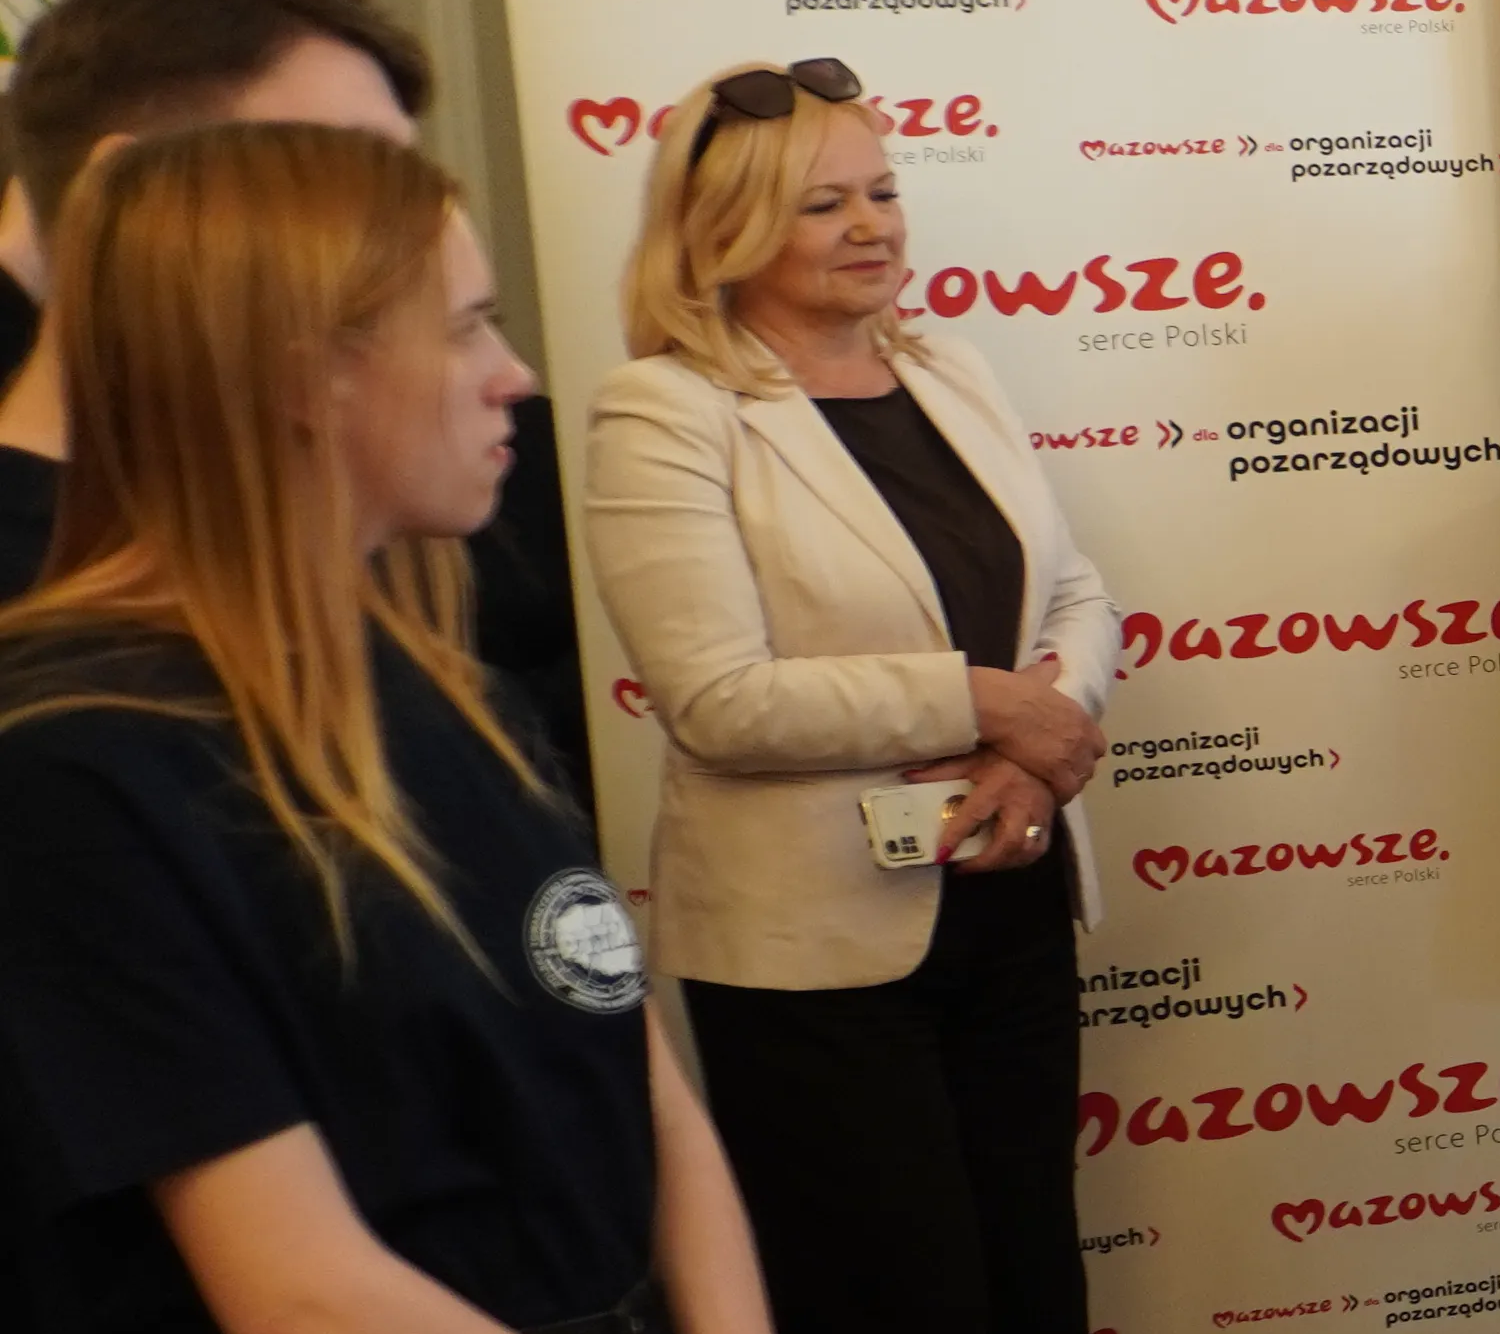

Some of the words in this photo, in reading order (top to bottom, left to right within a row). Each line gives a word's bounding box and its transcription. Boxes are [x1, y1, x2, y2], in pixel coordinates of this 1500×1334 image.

[1361, 22, 1403, 34] serce
[1409, 19, 1455, 34] Polski
[567, 94, 999, 157] Msze.
[924, 145, 985, 164] Polski
[1289, 128, 1433, 155] organizacji
[1291, 153, 1494, 182] pozarządowych
[896, 251, 1266, 319] owsze.
[1078, 329, 1154, 352] serce
[1165, 323, 1247, 348] Polski
[1028, 424, 1139, 450] owsze
[1192, 428, 1219, 441] dla
[1227, 406, 1419, 444] organizacji
[1399, 658, 1460, 680] serce
[1111, 727, 1260, 759] organizacji
[1113, 748, 1324, 787] pozarządowych
[1347, 873, 1388, 887] serce
[1395, 867, 1440, 884] Polski
[1079, 984, 1286, 1029] arządowych
[1394, 1131, 1465, 1155] serce
